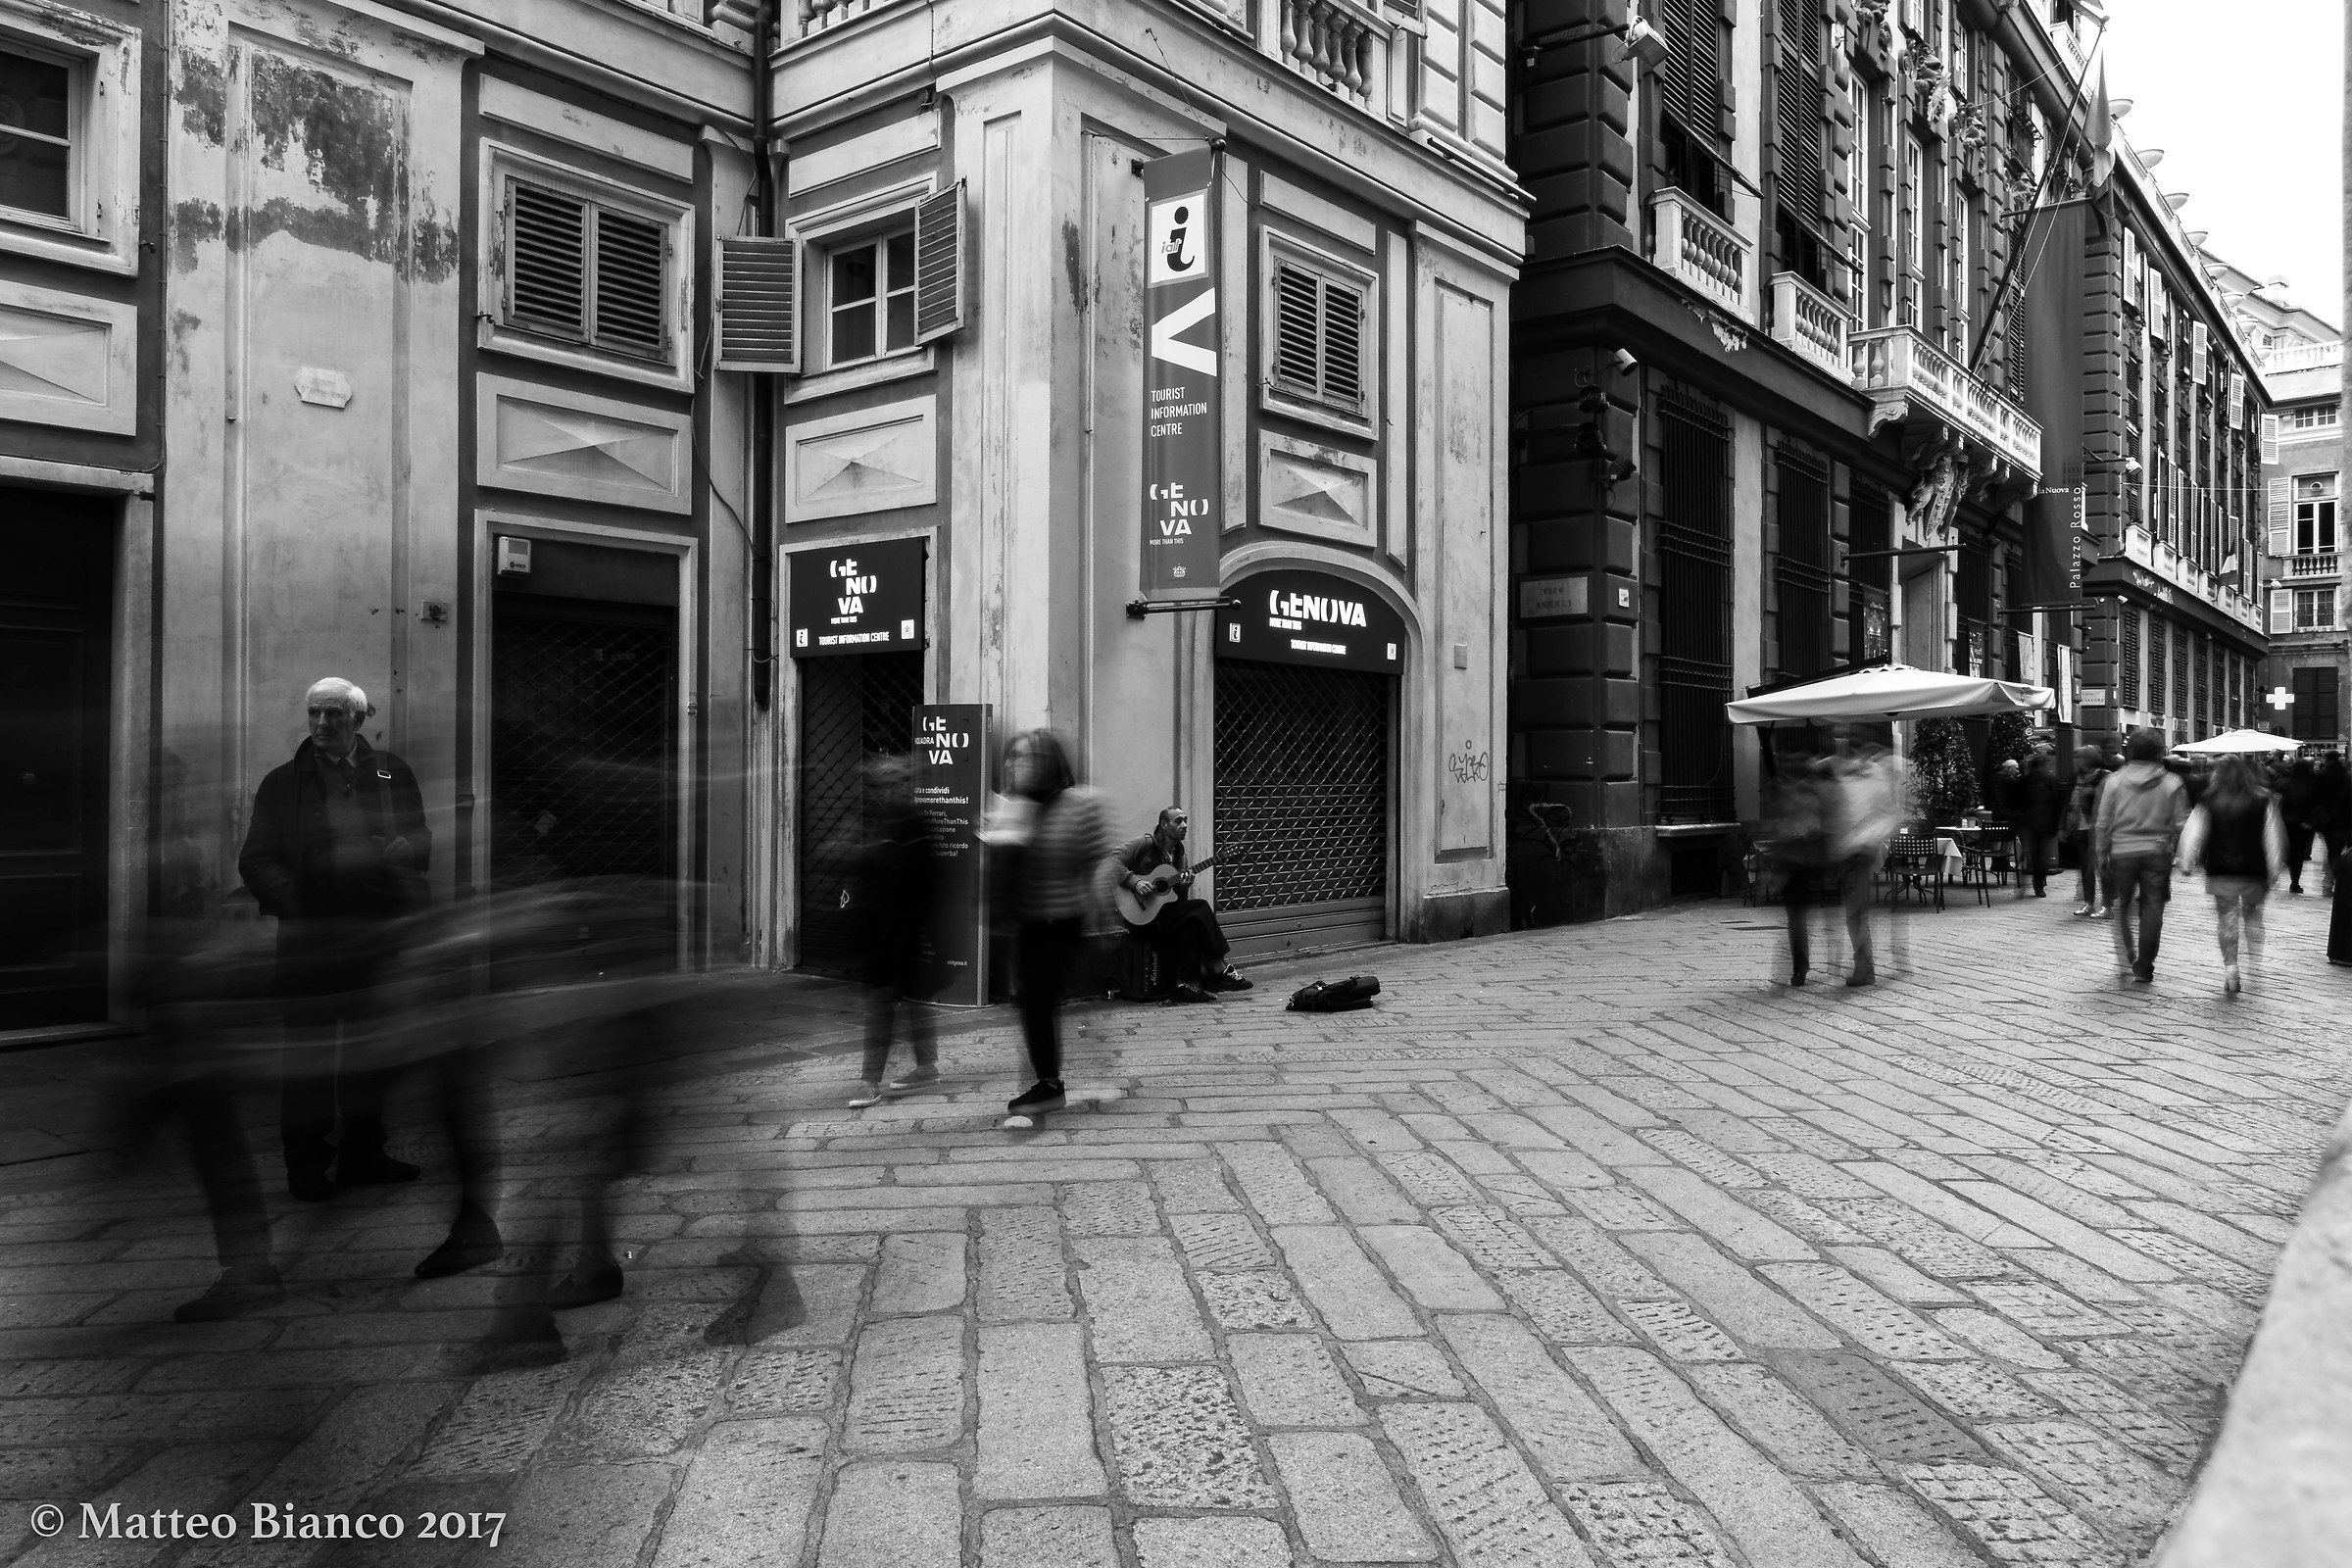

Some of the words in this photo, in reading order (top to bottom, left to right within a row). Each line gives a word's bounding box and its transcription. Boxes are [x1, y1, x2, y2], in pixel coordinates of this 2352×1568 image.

[1151, 386, 1186, 403] TOURIST
[1151, 402, 1207, 419] INFORMATION
[1151, 422, 1183, 437] CENTRE
[2070, 487, 2082, 528] Rosso
[2069, 536, 2082, 589] Palazzo
[1269, 589, 1367, 627] GENOVA
[818, 635, 838, 646] TOURIST
[838, 632, 870, 645] INFORMATION
[870, 631, 890, 643] CENTRE
[925, 786, 950, 795] condividi
